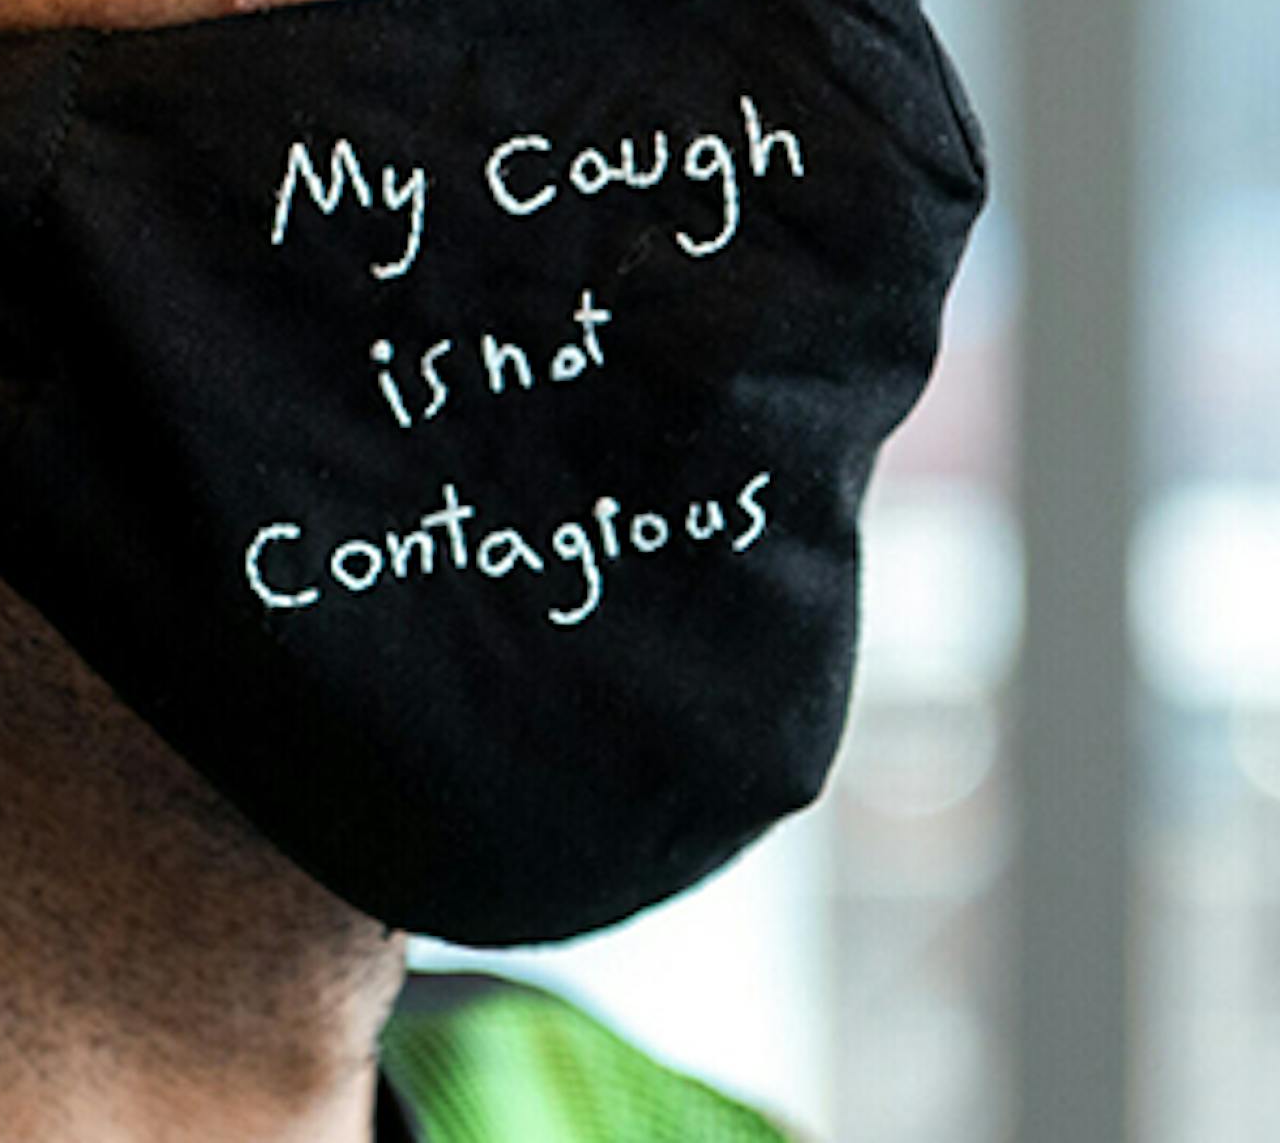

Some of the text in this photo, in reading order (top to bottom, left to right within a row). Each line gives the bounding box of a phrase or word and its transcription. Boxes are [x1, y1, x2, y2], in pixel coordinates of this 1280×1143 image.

[270, 95, 805, 280] My Cough
[370, 290, 611, 428] is not
[245, 472, 771, 625] Contagious
